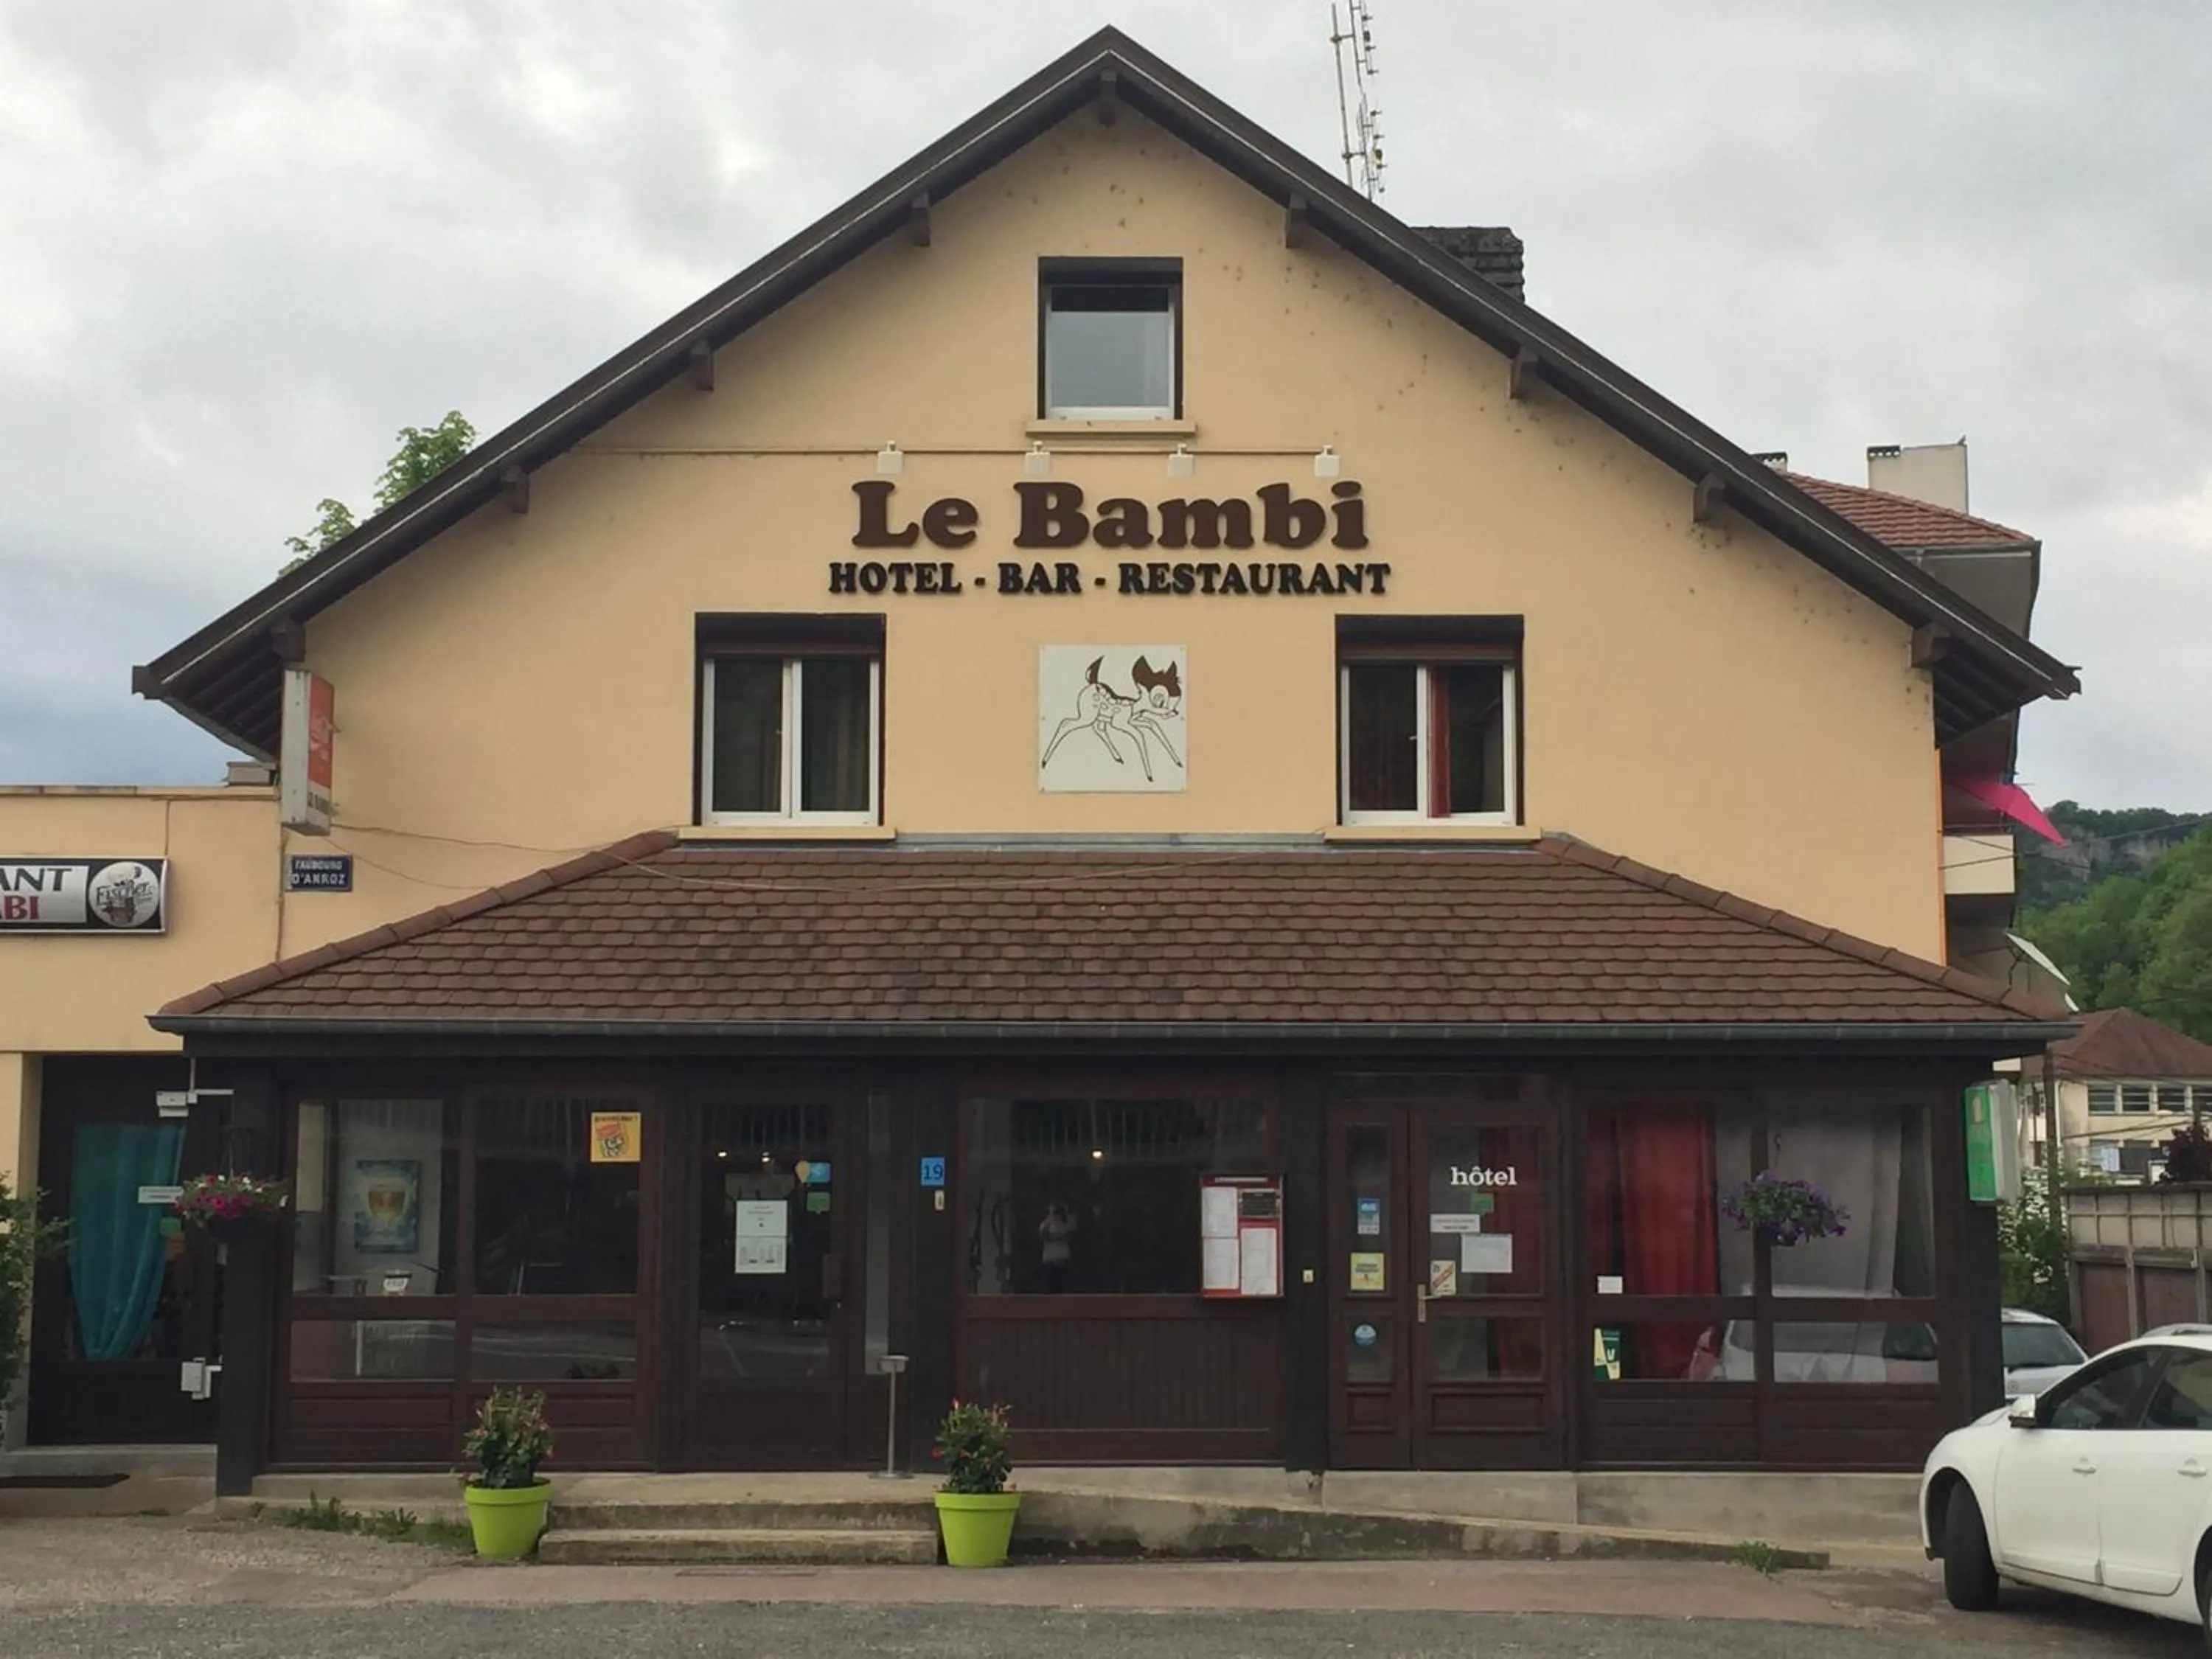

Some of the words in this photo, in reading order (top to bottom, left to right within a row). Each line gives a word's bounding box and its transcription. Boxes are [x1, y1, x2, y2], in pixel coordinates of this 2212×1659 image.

[852, 481, 978, 549] Le
[1013, 481, 1369, 549] Bambi
[829, 563, 962, 594] HOTEL
[998, 563, 1082, 594] BAR
[1118, 563, 1391, 594] RESTAURANT
[0, 895, 40, 919] BI
[924, 1164, 943, 1180] 19
[1450, 1166, 1517, 1186] hôtel
